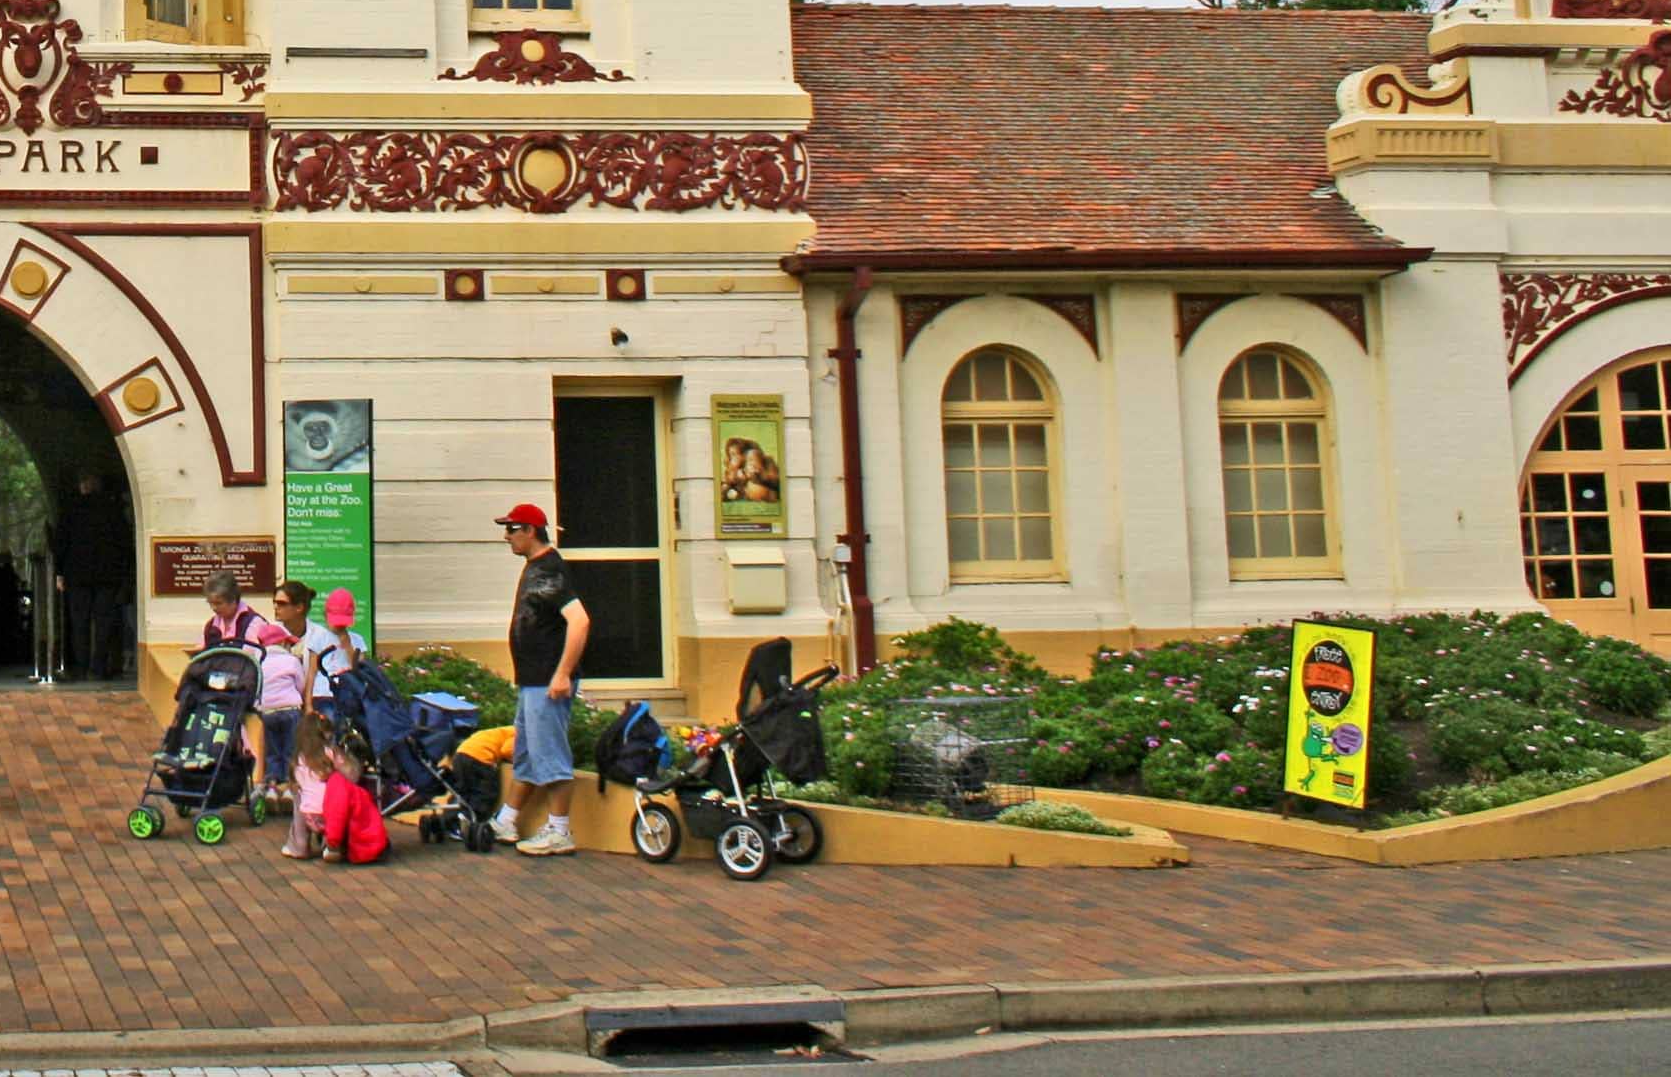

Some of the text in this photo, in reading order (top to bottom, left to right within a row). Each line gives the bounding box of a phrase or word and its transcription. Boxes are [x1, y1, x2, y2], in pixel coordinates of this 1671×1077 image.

[287, 483, 353, 493] Have a Great
[287, 495, 307, 507] Day
[309, 496, 320, 505] at
[321, 495, 338, 505] the
[287, 507, 313, 517] Don't
